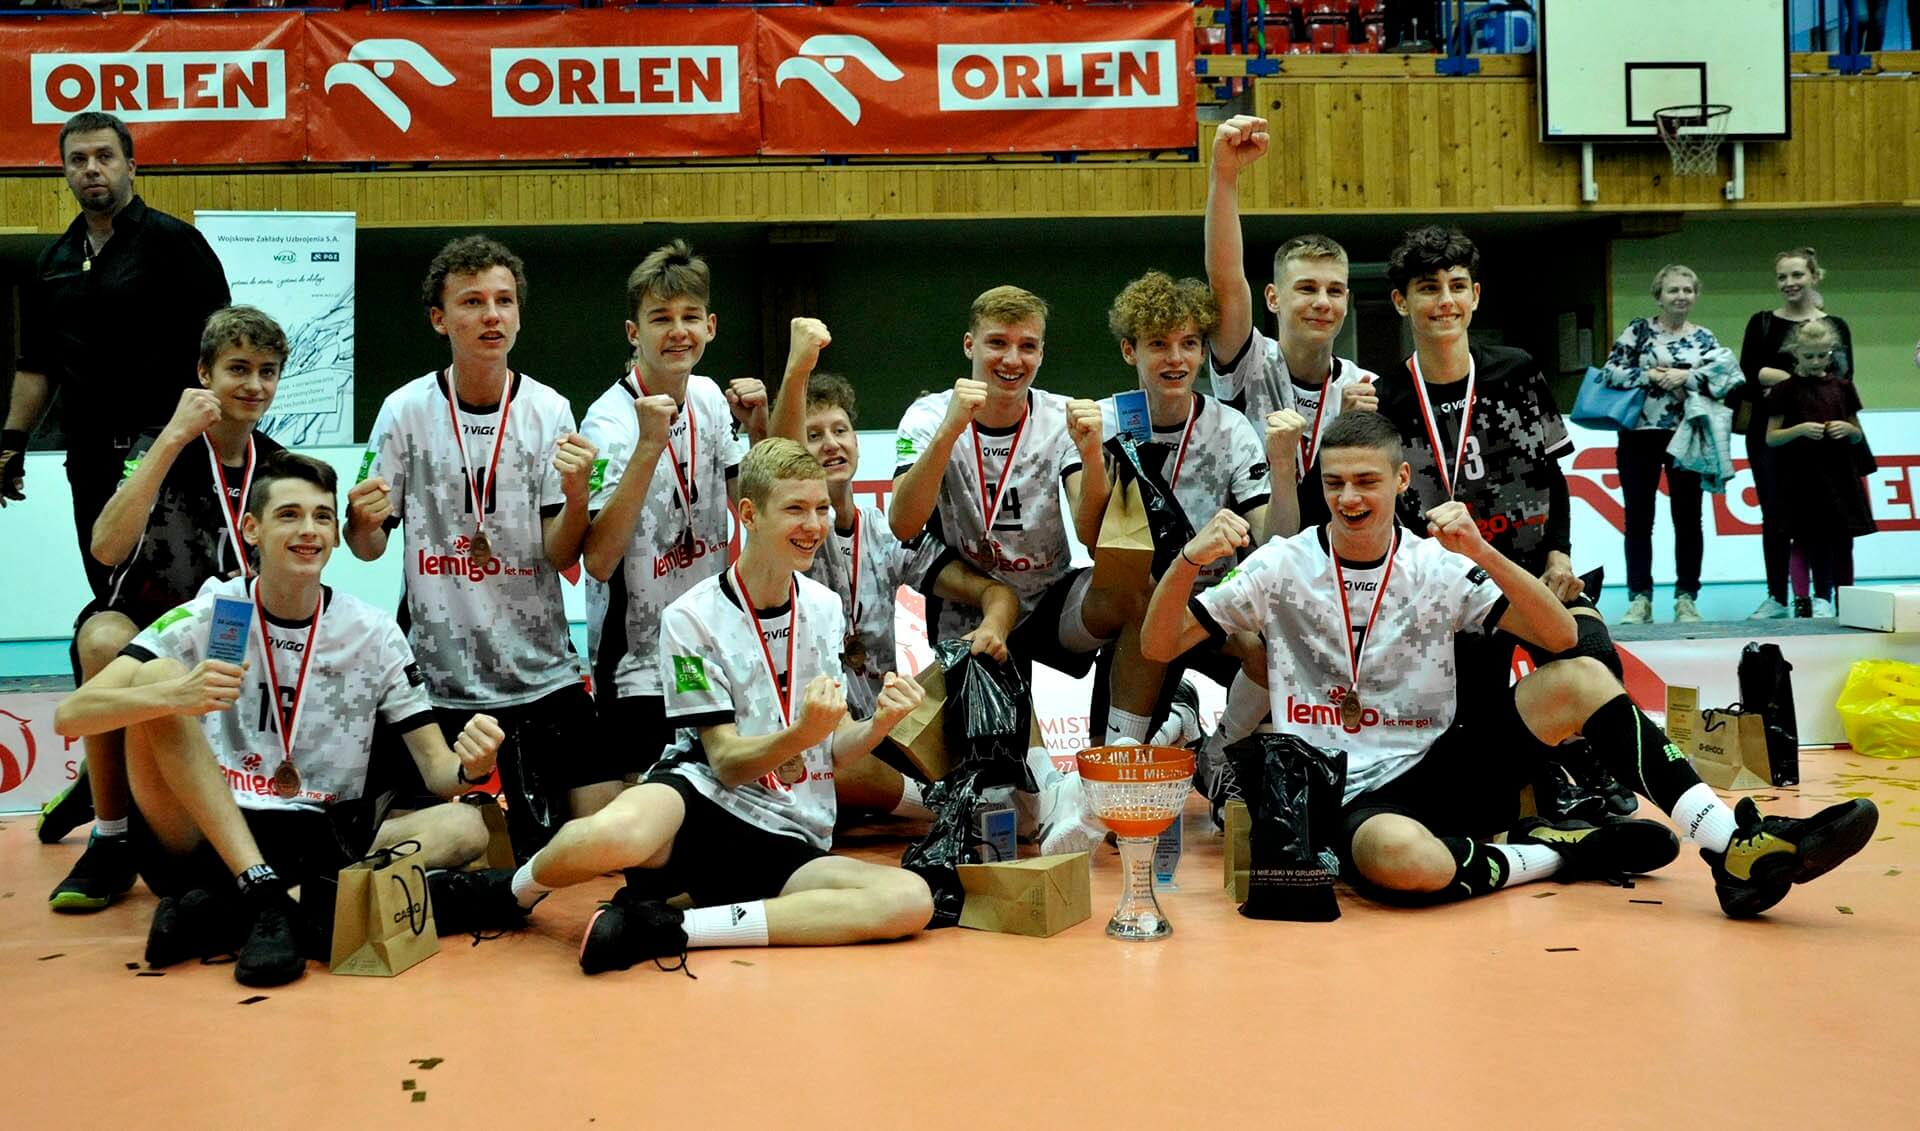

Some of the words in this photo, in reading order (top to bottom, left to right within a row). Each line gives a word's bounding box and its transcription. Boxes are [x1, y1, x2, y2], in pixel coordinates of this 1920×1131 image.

[45, 61, 269, 112] ORLEN
[505, 58, 722, 106] ORLEN
[951, 52, 1160, 100] ORLEN
[217, 234, 255, 243] Wojskowe
[285, 234, 324, 244] Uzbrojenia
[326, 235, 340, 243] S.A.
[1382, 716, 1396, 727] let
[1397, 717, 1414, 727] me
[1689, 803, 1716, 839] adidas
